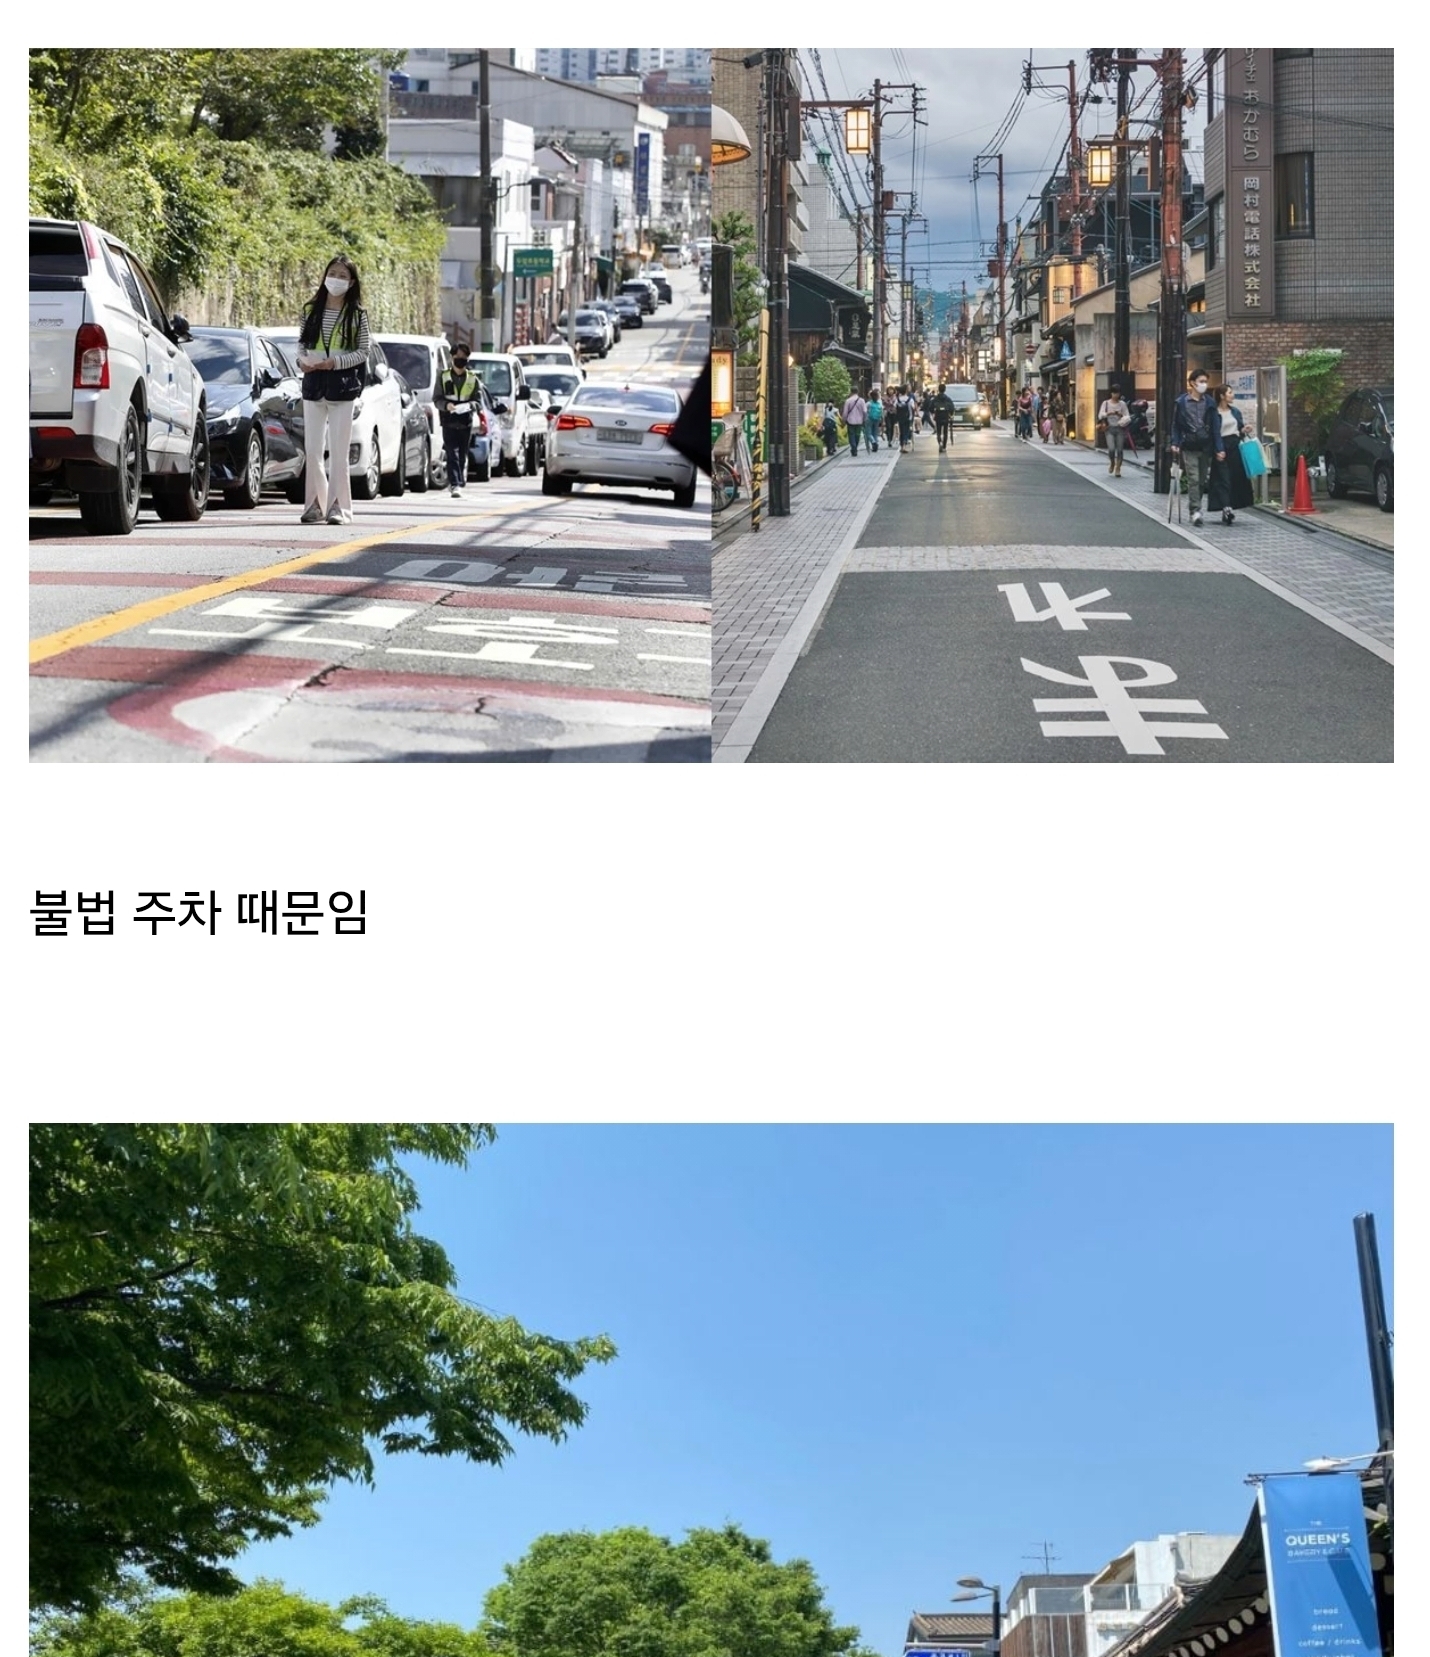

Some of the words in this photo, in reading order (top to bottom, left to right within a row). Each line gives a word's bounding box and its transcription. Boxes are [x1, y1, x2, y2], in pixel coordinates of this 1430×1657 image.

[1243, 90, 1260, 161] おかむら
[1243, 176, 1261, 307] 岡村電話株式会社
[1285, 1532, 1351, 1546] QUEEN'S
